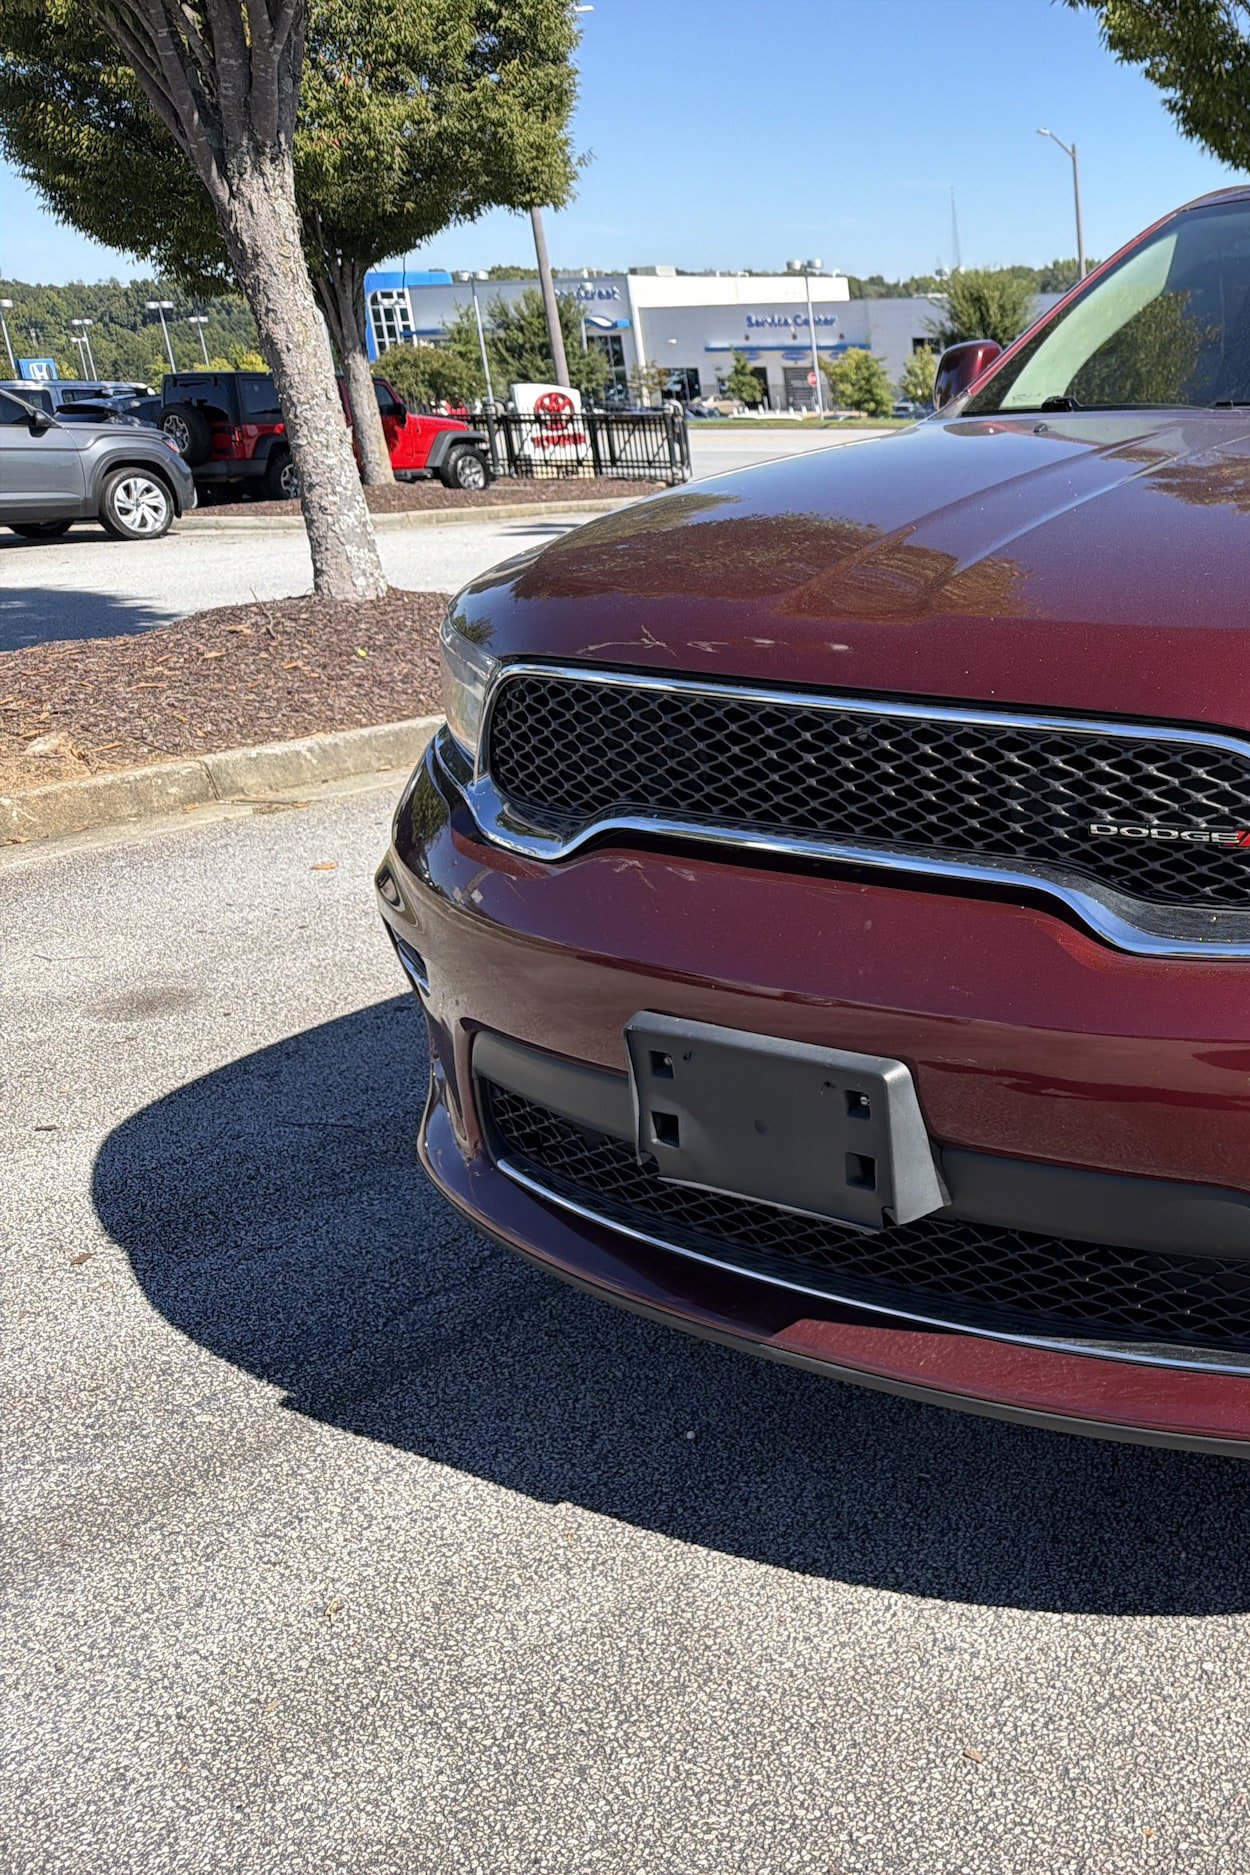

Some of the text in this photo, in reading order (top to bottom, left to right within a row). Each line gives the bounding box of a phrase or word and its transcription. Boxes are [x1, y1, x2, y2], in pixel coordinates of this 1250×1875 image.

[746, 313, 836, 328] Service Ceter
[1089, 823, 1240, 843] DODGE
